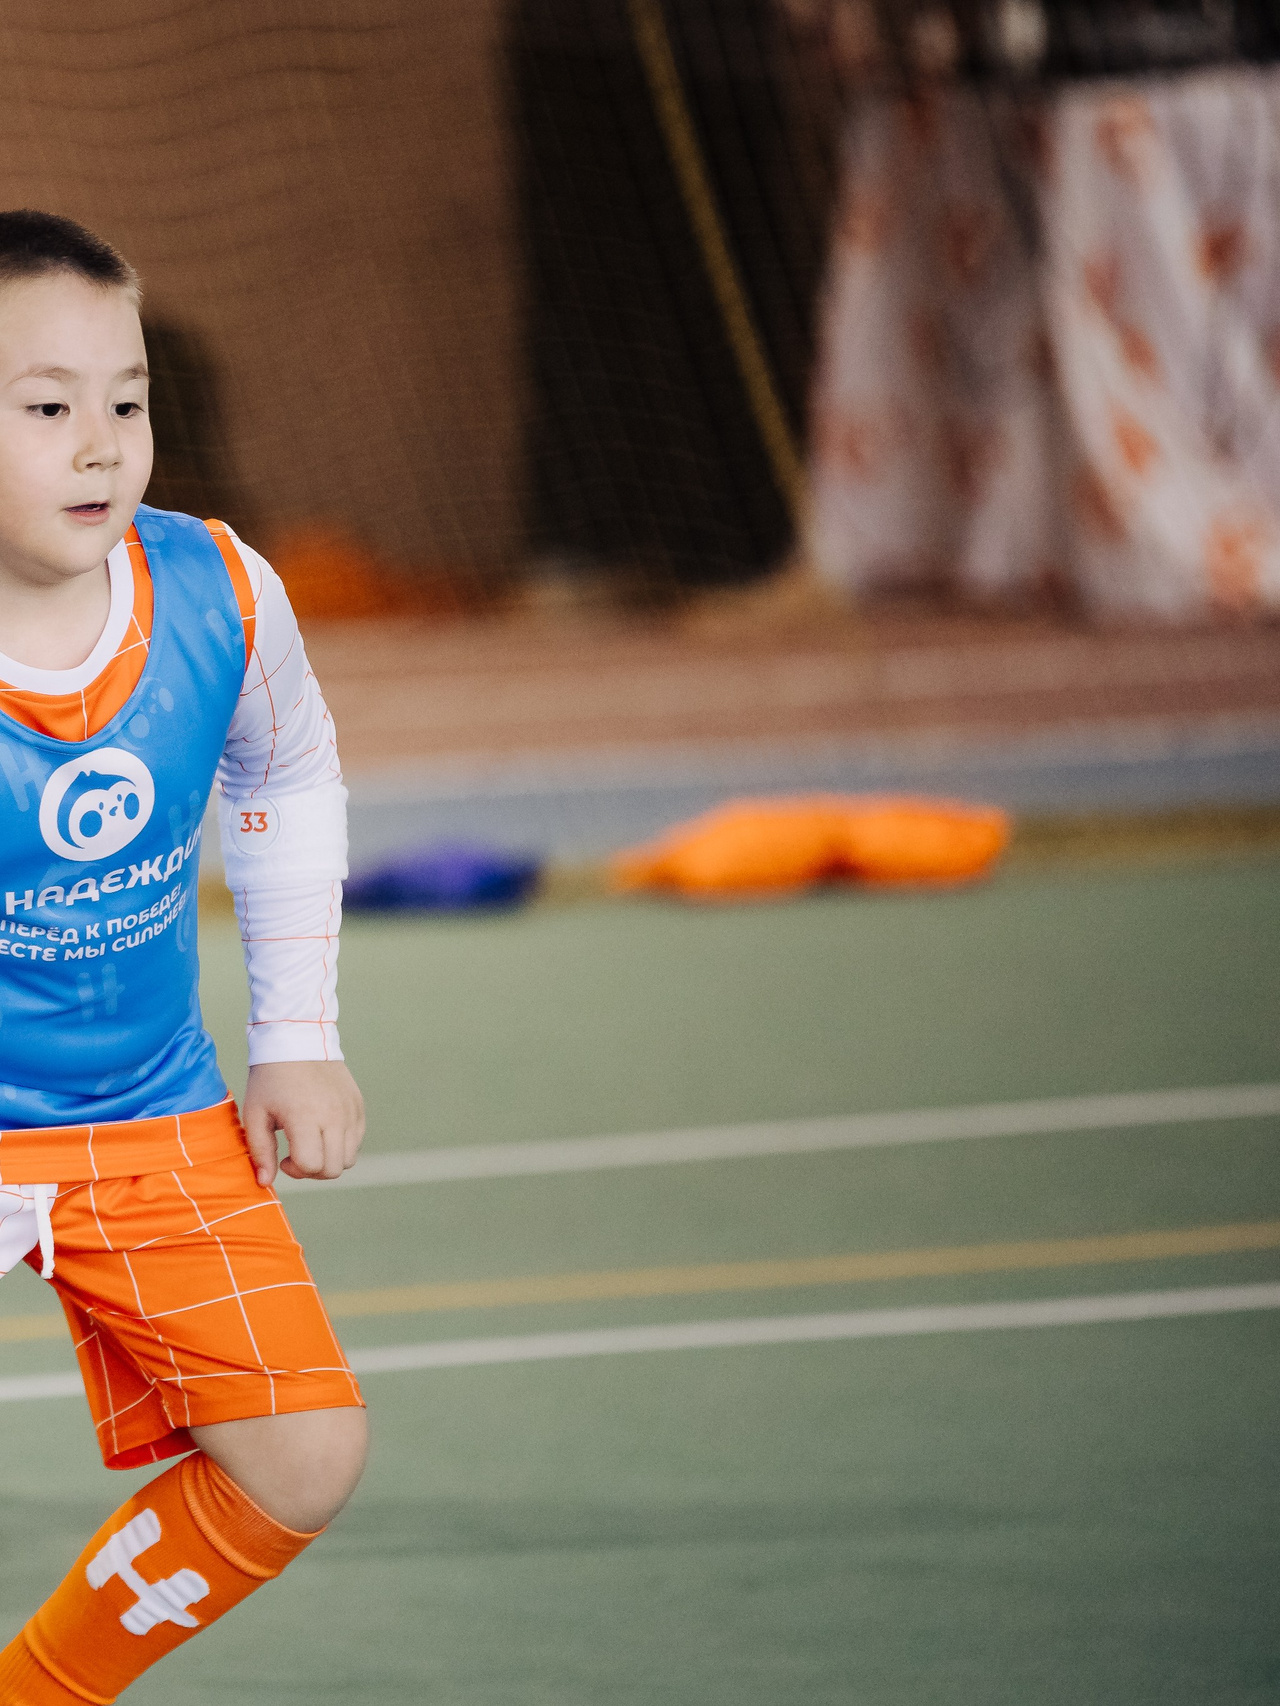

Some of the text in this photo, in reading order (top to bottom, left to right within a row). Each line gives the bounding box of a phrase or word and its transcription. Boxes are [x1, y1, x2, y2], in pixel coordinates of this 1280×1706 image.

[240, 812, 268, 833] 33
[86, 922, 100, 940] К
[106, 882, 182, 936] ПОБЕДЕ!
[63, 943, 106, 961] МЫ
